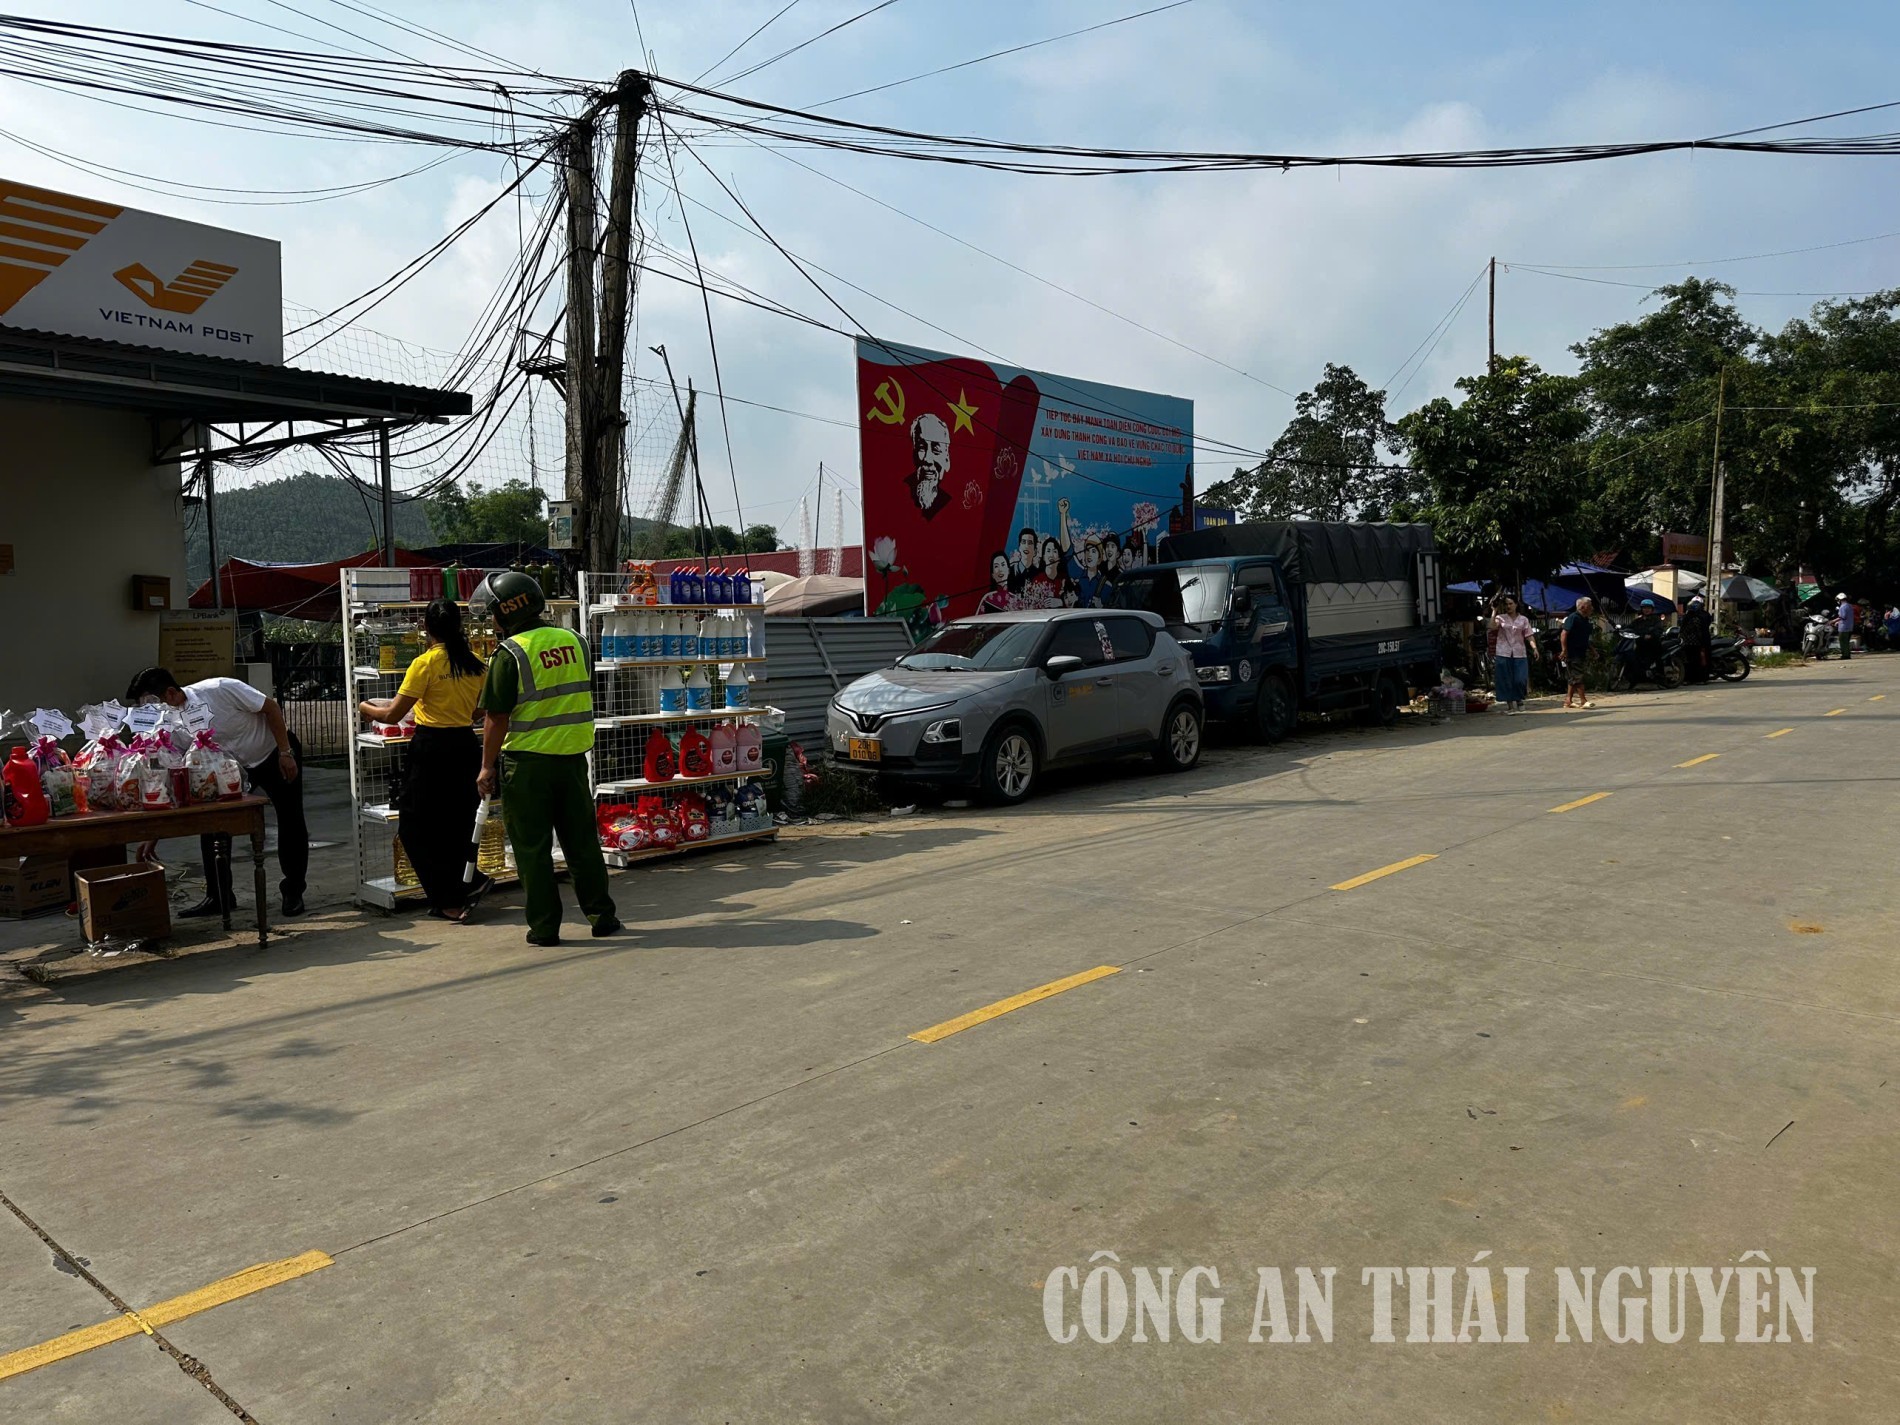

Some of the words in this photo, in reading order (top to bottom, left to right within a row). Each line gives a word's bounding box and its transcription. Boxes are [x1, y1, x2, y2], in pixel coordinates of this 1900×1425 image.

[99, 308, 193, 334] VIETNAM
[203, 326, 254, 344] POST
[499, 592, 530, 615] CSTT
[539, 645, 577, 669] CSTT
